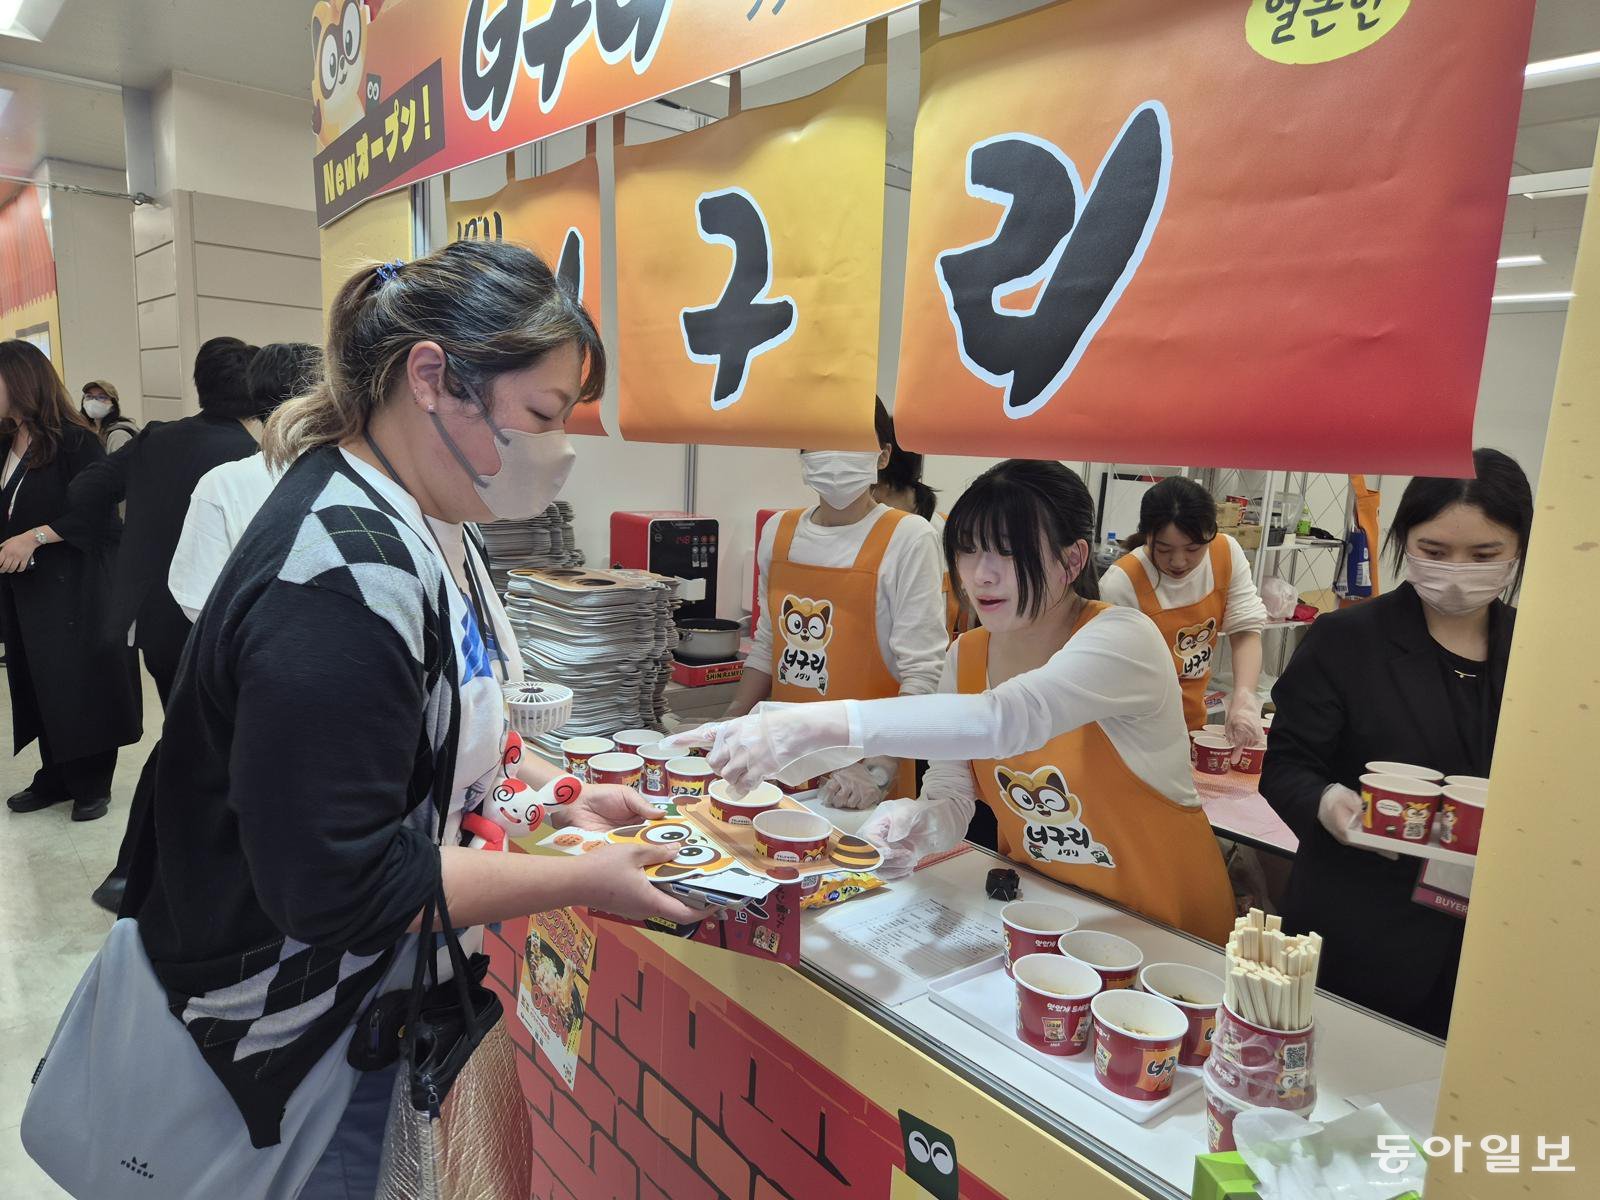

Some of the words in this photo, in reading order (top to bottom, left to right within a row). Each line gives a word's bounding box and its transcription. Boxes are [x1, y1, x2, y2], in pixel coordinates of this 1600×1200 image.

[680, 186, 797, 411] 구
[935, 100, 1172, 419] 리
[784, 648, 826, 674] 너구리
[1026, 825, 1090, 849] 너구리
